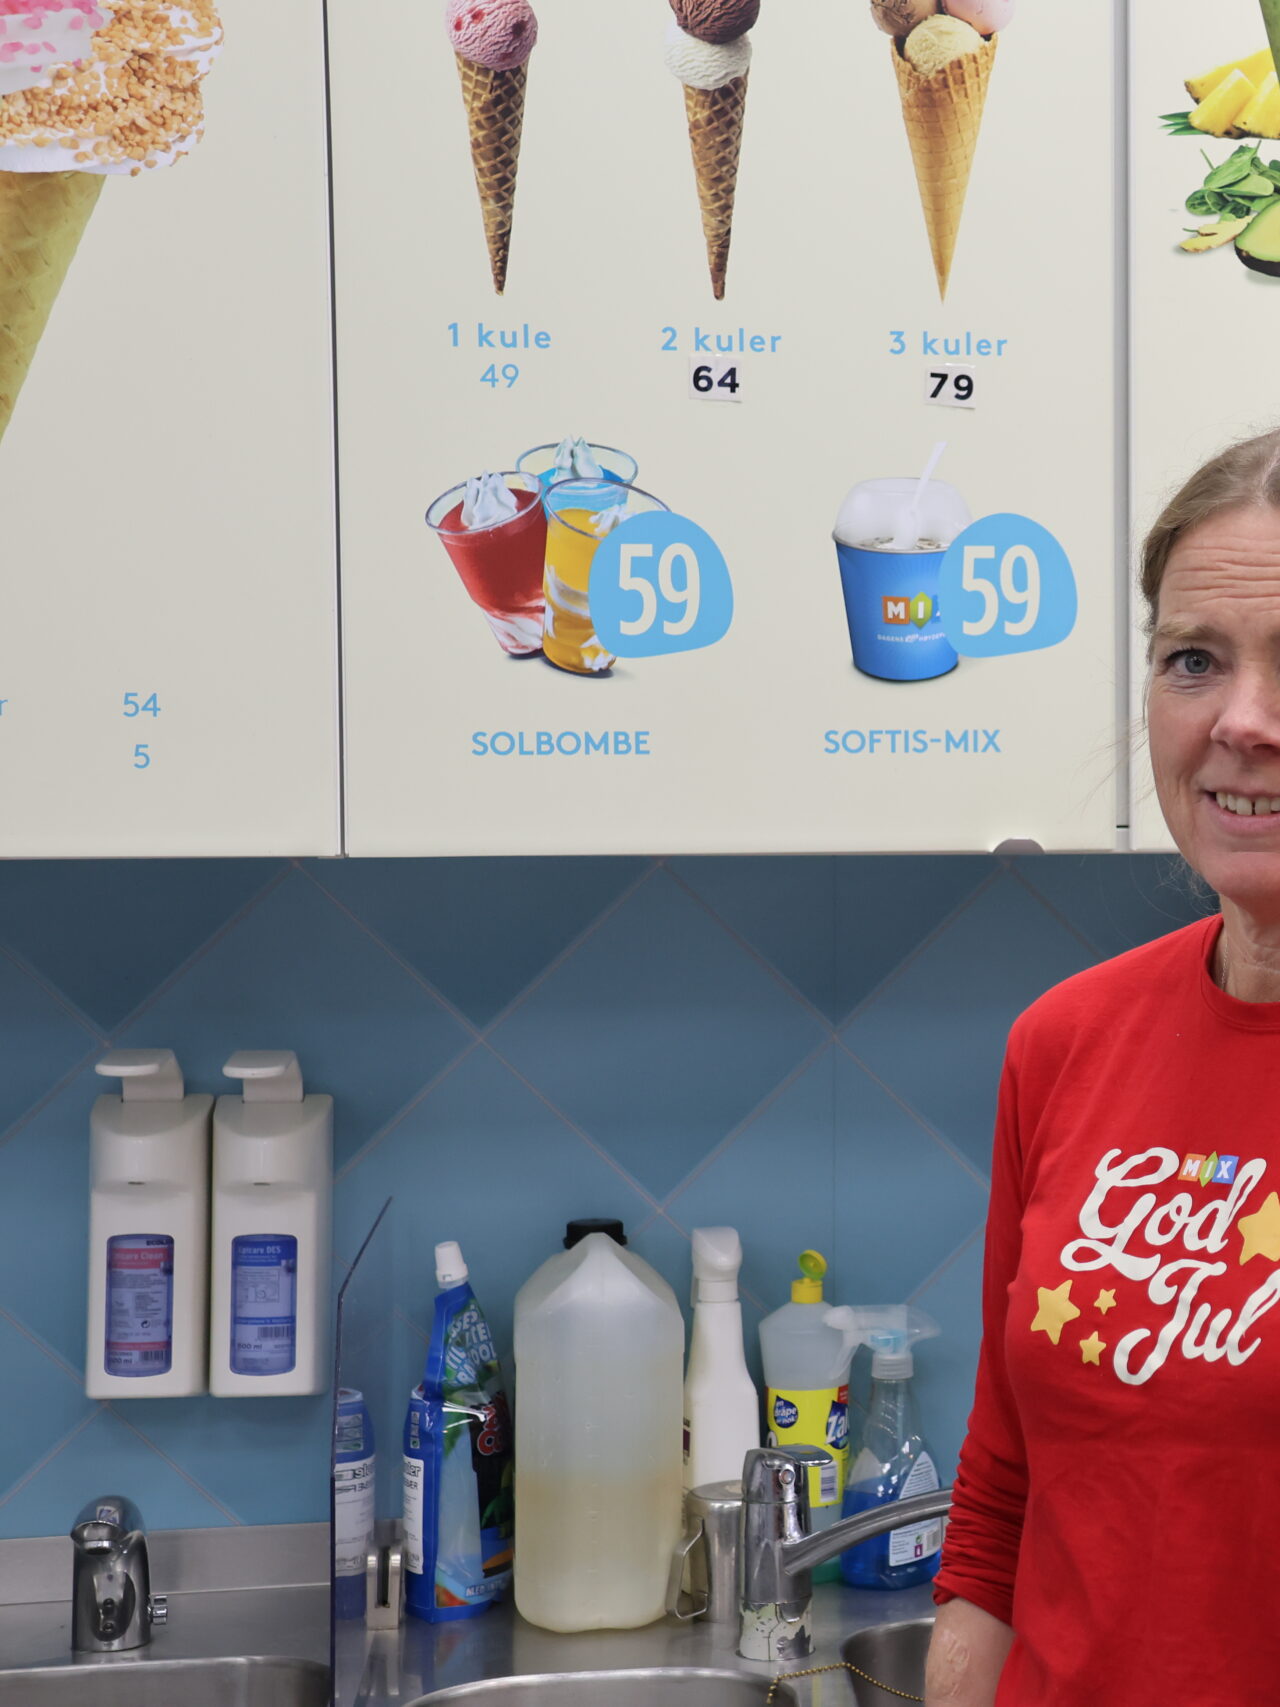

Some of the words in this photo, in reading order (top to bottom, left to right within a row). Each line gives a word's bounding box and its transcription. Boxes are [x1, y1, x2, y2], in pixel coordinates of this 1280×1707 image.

[447, 322, 460, 347] 1
[477, 323, 552, 349] kule
[661, 326, 678, 351] 2
[694, 327, 782, 353] kuler
[889, 330, 906, 355] 3
[922, 331, 1009, 357] kuler
[479, 363, 520, 389] 49
[691, 365, 741, 395] 64
[928, 372, 975, 401] 79
[617, 542, 701, 636] 59
[961, 544, 1041, 637] 59
[123, 692, 161, 718] 54
[472, 731, 651, 756] SOLBOMBE
[823, 729, 1001, 755] SOFTIS-MIX
[134, 743, 151, 769] 5
[1180, 1156, 1237, 1181] MIX
[1060, 1146, 1267, 1282] God
